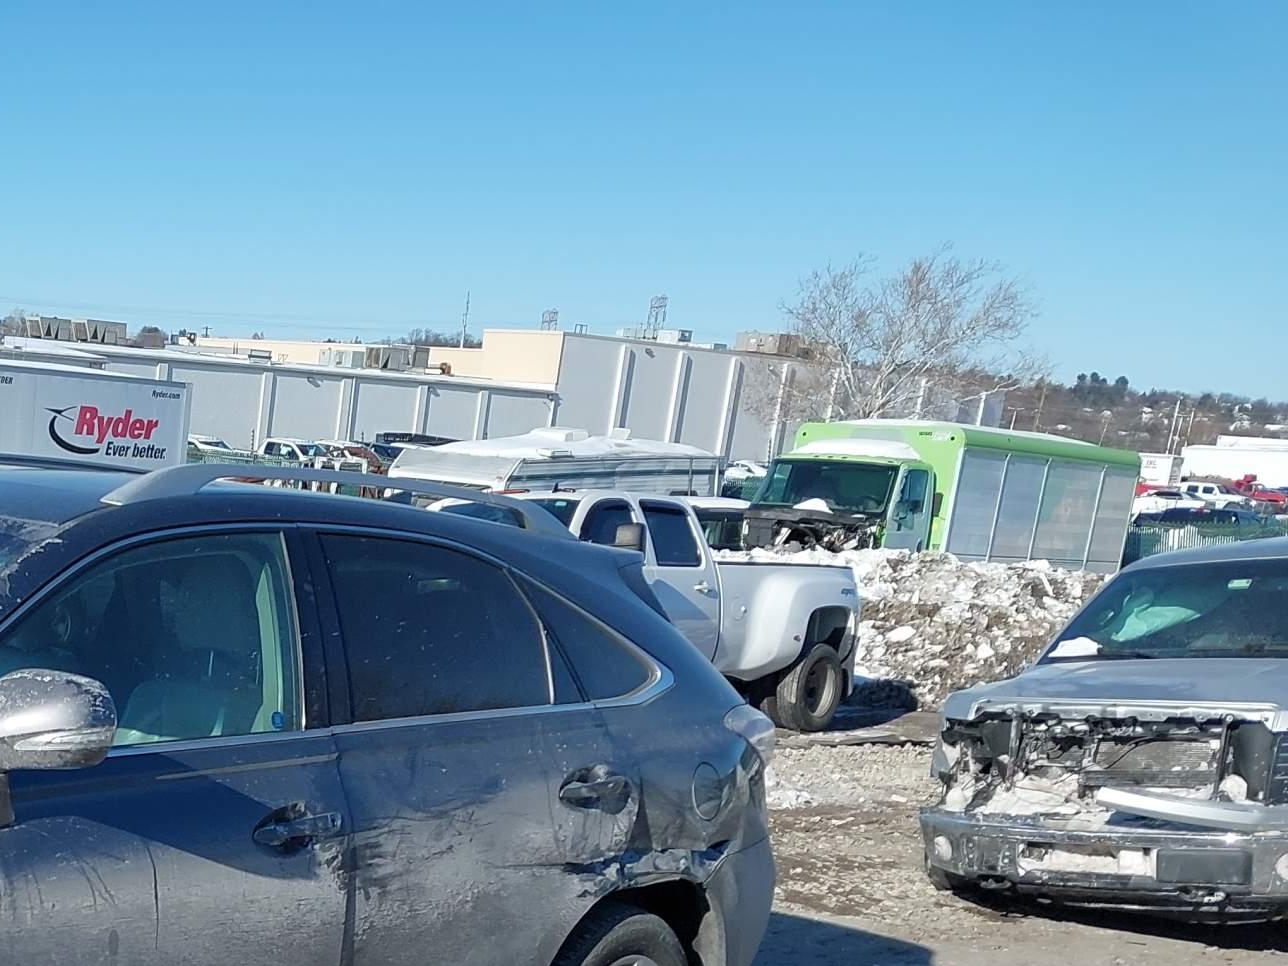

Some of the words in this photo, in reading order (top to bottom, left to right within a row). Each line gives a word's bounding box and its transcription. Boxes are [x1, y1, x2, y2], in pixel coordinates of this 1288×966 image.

[151, 389, 181, 400] Ryder.com
[74, 405, 159, 444] Ryder
[104, 441, 132, 457] Ever
[132, 443, 167, 459] better.
